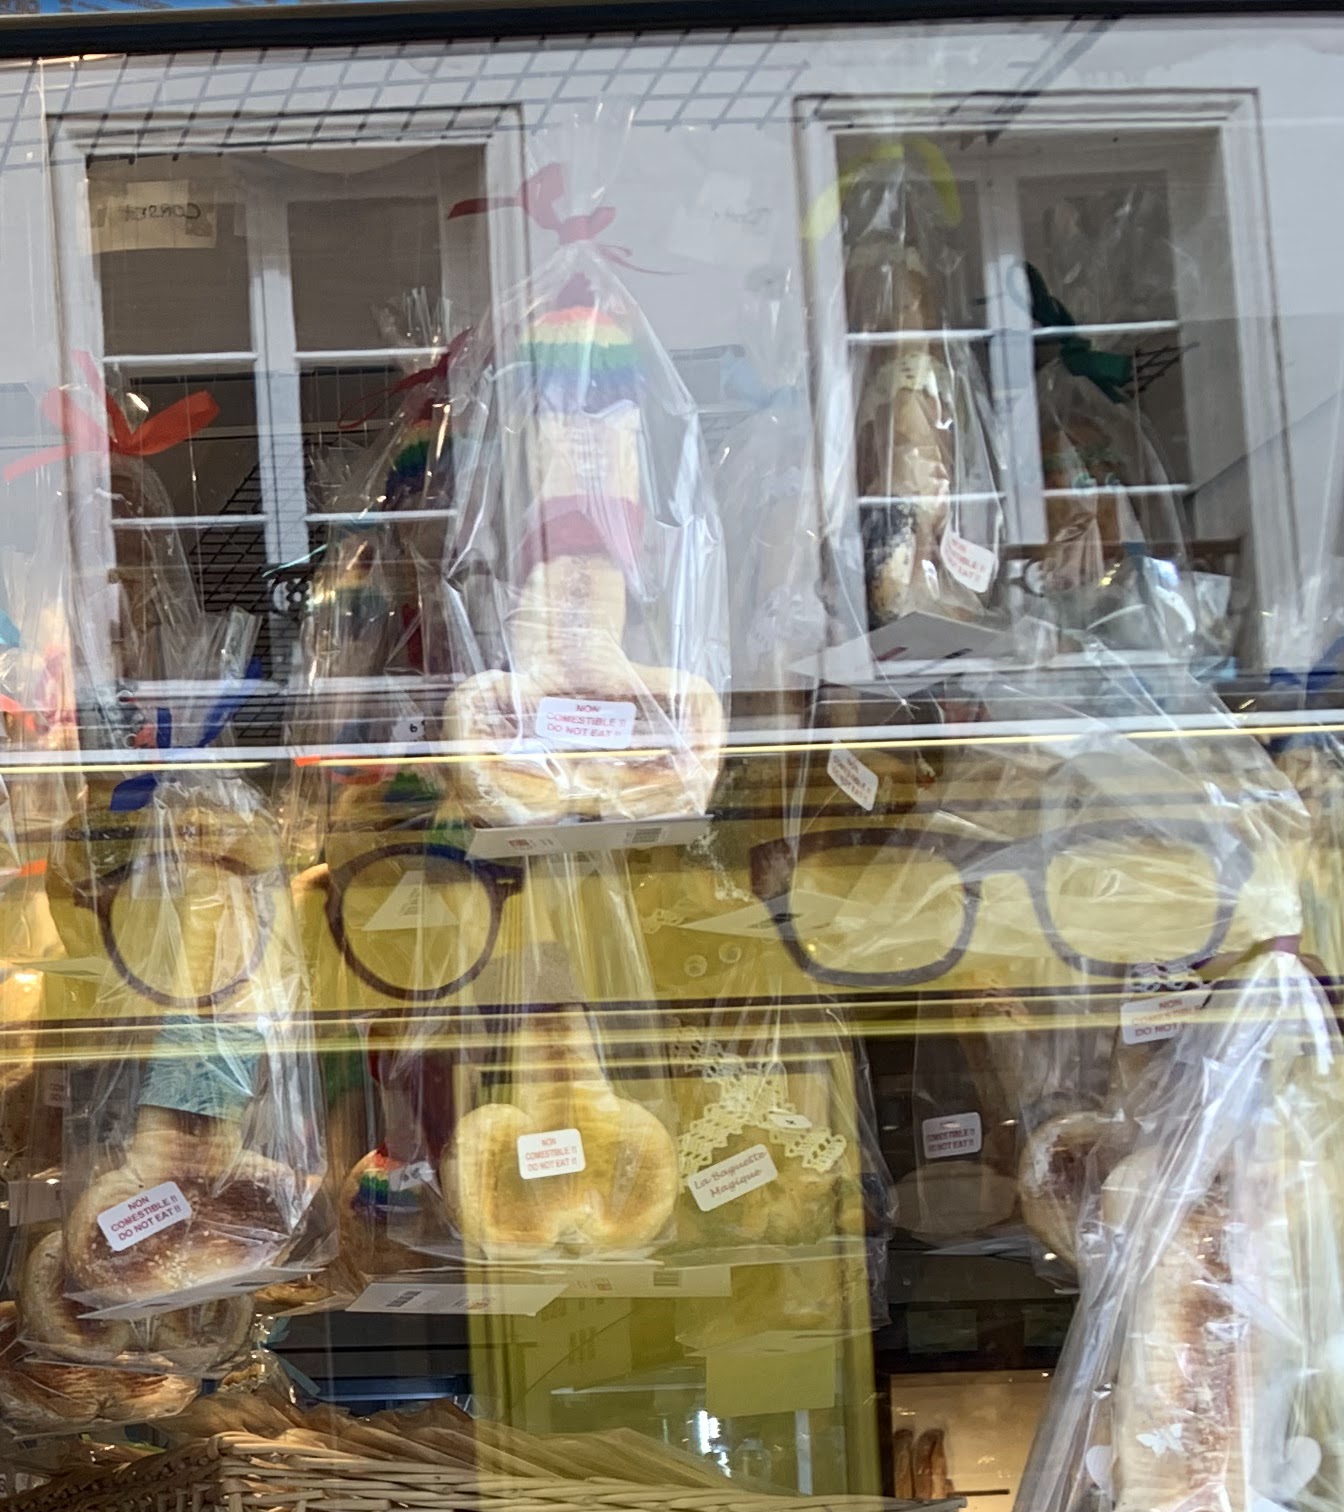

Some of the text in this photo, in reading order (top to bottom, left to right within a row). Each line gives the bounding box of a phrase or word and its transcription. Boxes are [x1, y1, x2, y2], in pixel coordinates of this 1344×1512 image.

[694, 1151, 769, 1190] La Baguette
[709, 1169, 761, 1198] Magique
[111, 1198, 170, 1232] COMESTIBLE
[128, 1196, 149, 1210] NON
[118, 1229, 134, 1241] DO
[134, 1218, 154, 1233] NOT
[154, 1209, 174, 1223] EAT
